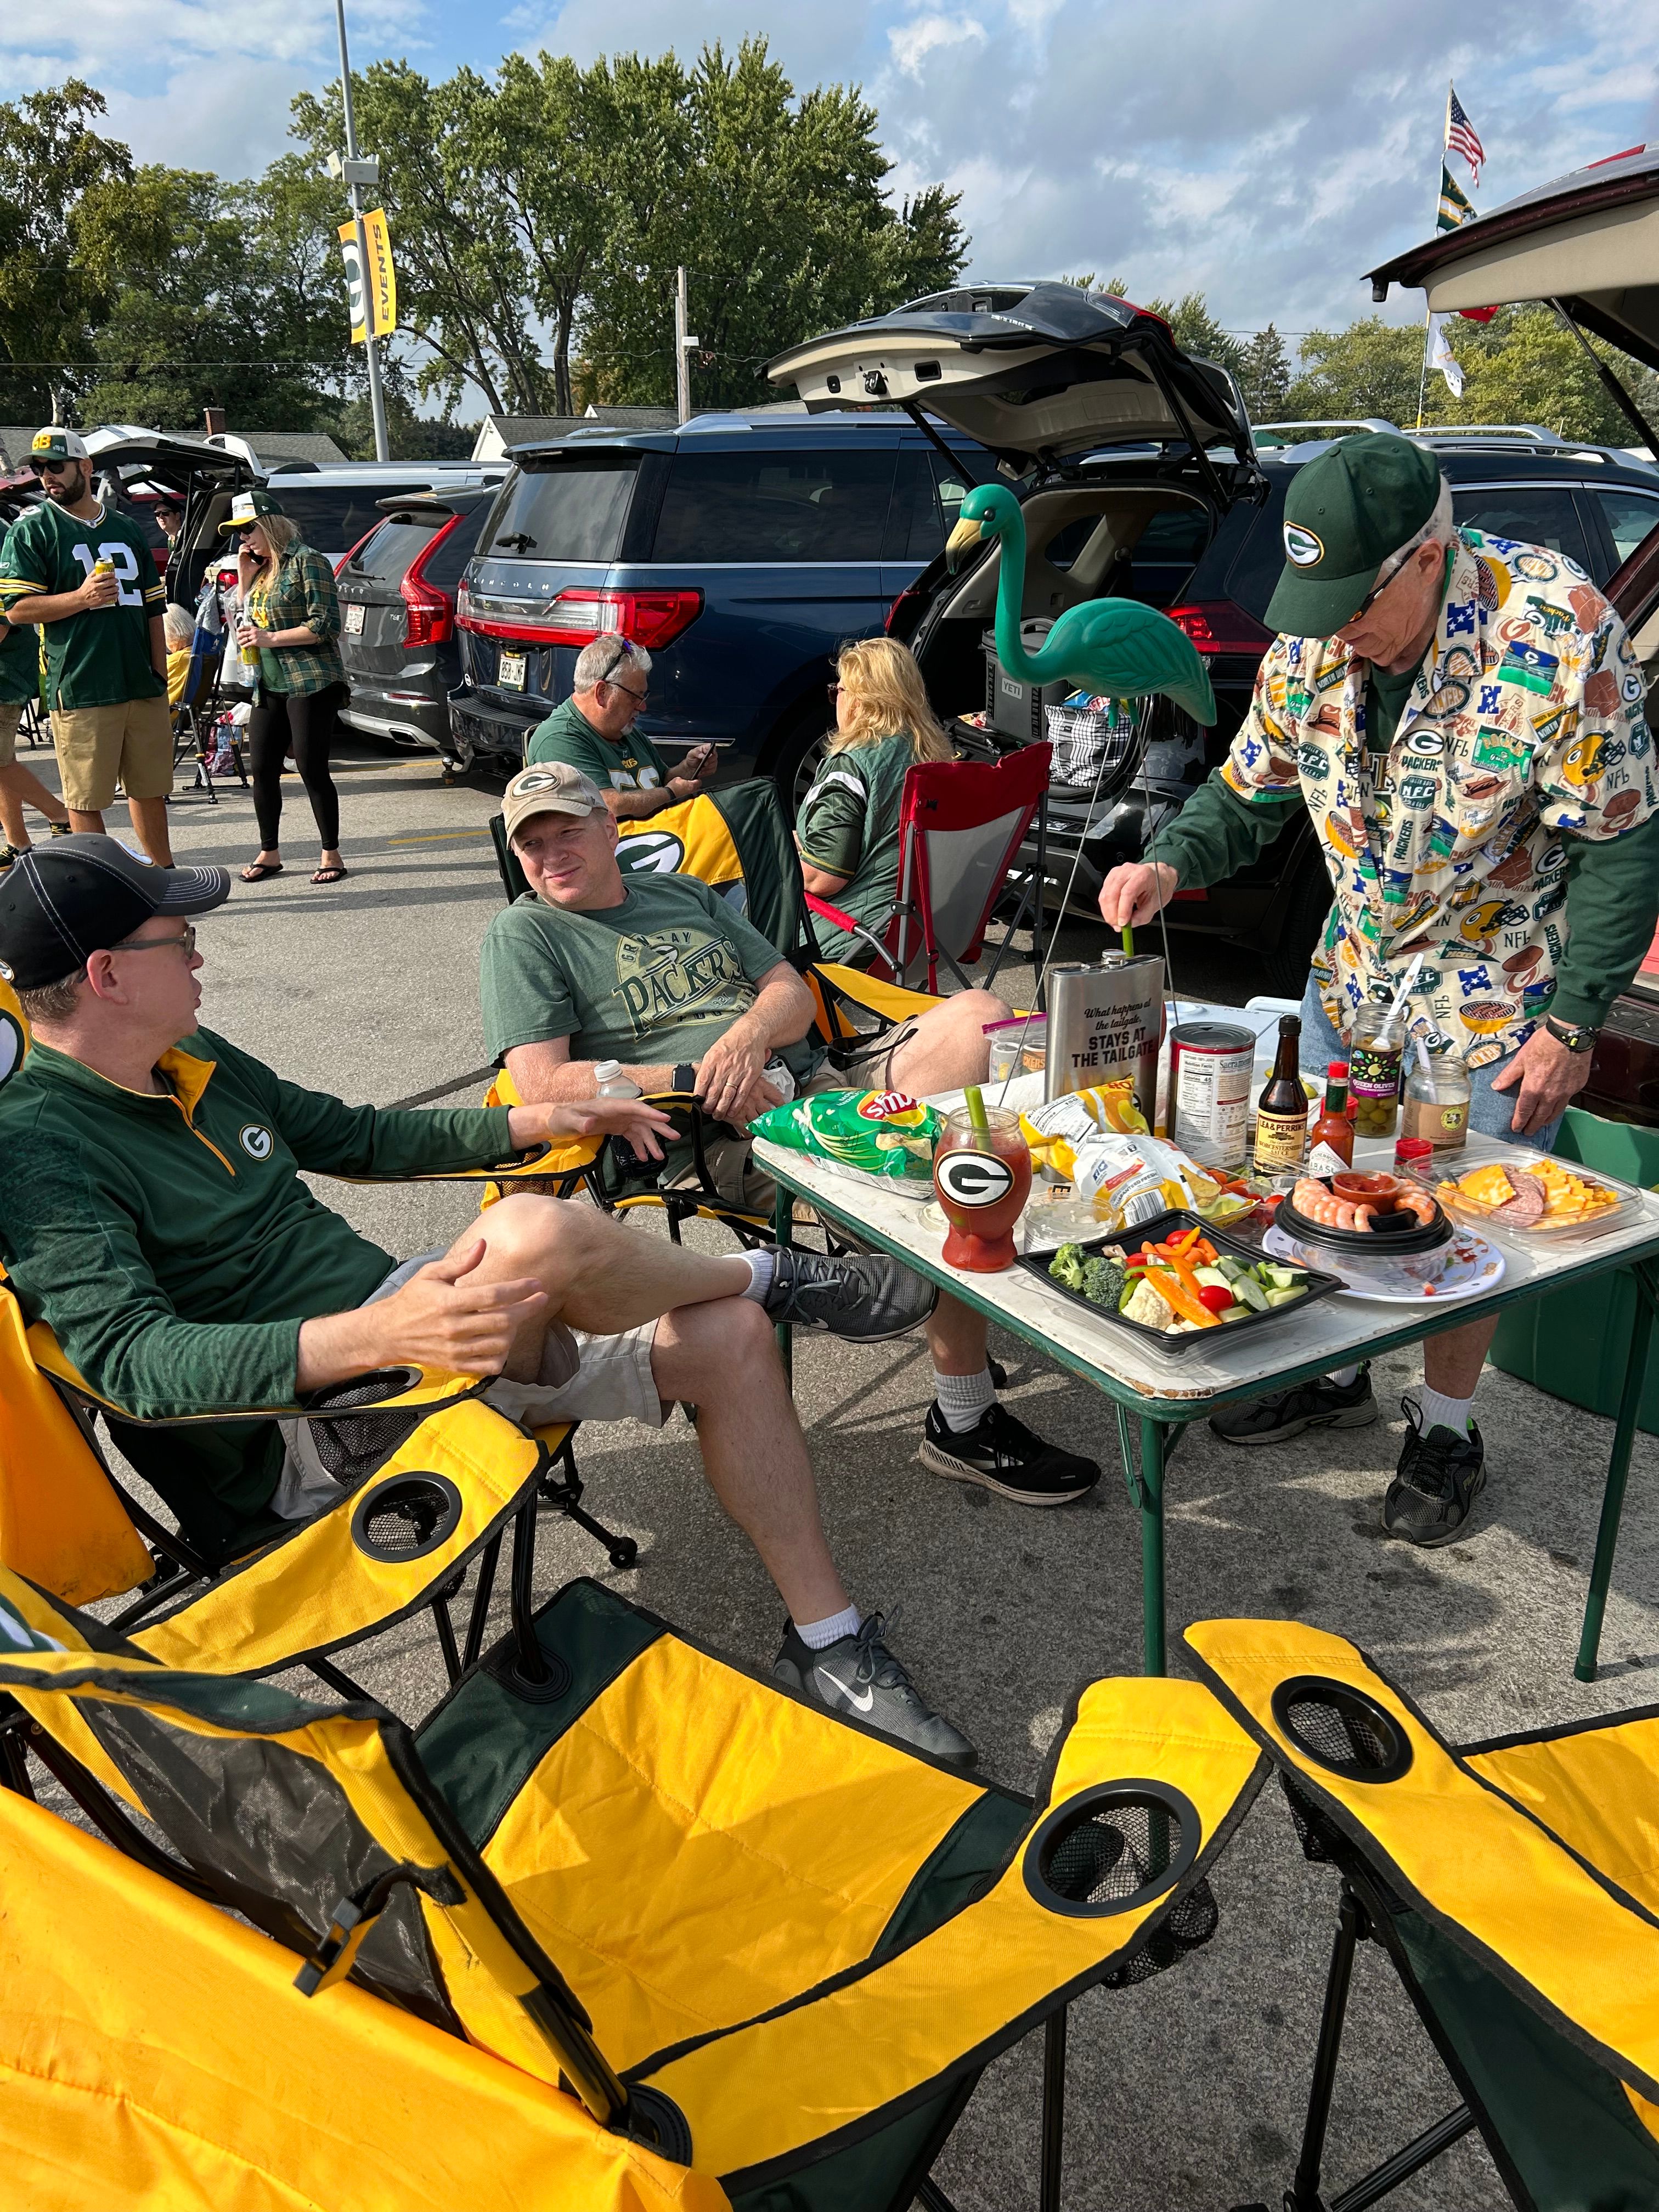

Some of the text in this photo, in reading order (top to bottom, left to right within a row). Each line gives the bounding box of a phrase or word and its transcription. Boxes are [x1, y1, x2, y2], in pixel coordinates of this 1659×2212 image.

[373, 224, 389, 321] EVENTS
[473, 578, 549, 590] LINCOLN
[1003, 681, 1020, 695] YETI
[1407, 730, 1444, 755] G
[1444, 736, 1469, 758] NFL
[1402, 785, 1435, 797] NFC
[1607, 768, 1629, 791] NFL
[1393, 819, 1414, 860] PACKERS
[1537, 843, 1566, 873] G
[1504, 930, 1531, 948] NFL
[1544, 924, 1563, 966] PACKERS
[612, 937, 742, 1041] PACKERS
[1084, 997, 1152, 1019] What happens at
[1435, 995, 1452, 1019] NFL
[1095, 1014, 1142, 1030] the tailgate,
[1088, 1026, 1146, 1050] STAYS AT
[1023, 1054, 1045, 1069] CKERS
[1072, 1039, 1155, 1068] THE TAILGATE
[866, 1091, 913, 1118] ay's
[1039, 1111, 1056, 1132] Calories
[1260, 1120, 1269, 1129] LEA
[1276, 1122, 1305, 1131] PERRINS
[243, 1128, 272, 1158] G
[938, 1153, 1012, 1204] G
[1141, 1172, 1158, 1182] FRESH
